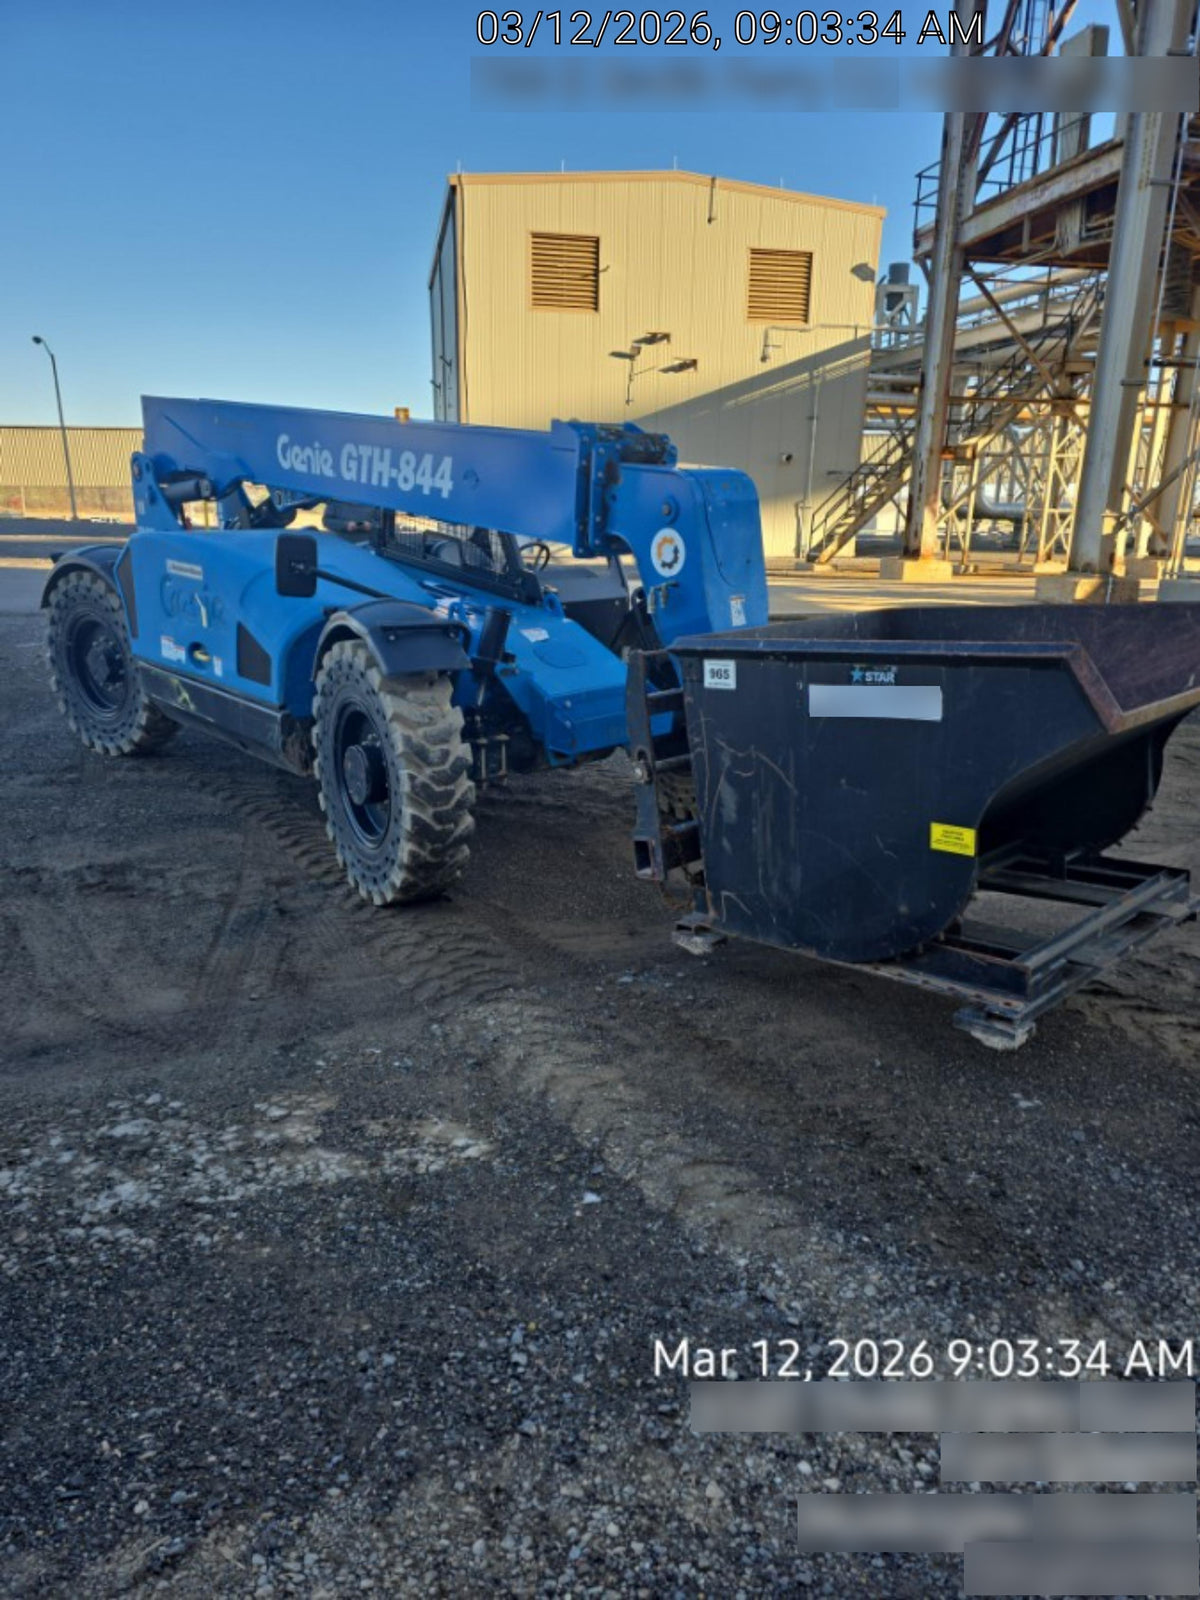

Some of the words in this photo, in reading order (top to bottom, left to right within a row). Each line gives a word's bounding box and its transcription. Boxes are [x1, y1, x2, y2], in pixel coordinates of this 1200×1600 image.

[276, 434, 336, 478] Genie
[340, 443, 453, 498] GTH-844
[708, 667, 731, 680] 965
